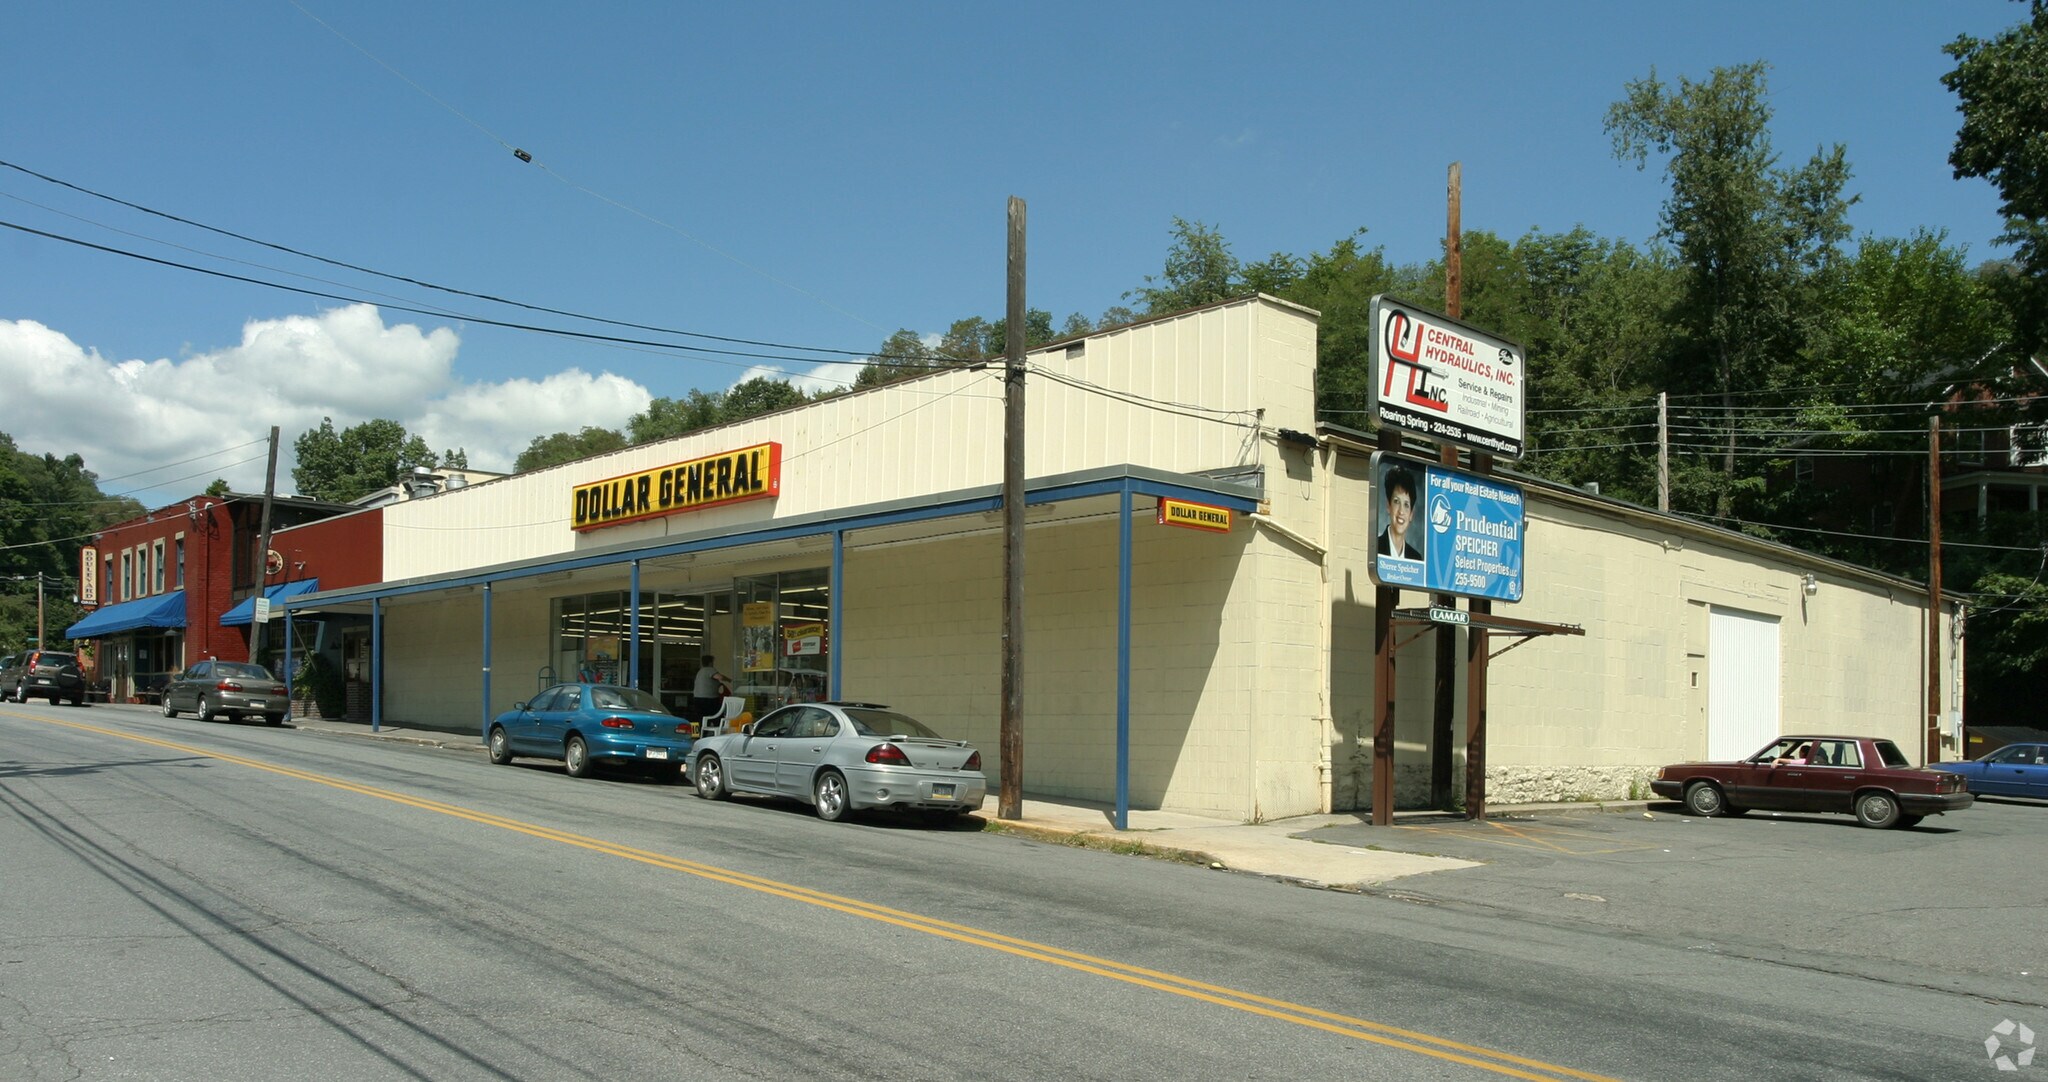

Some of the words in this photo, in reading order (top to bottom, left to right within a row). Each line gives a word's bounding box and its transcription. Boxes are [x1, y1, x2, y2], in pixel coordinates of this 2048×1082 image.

[1428, 329, 1474, 356] CENTRAL
[1425, 345, 1494, 381] HYDRAULICS,
[1495, 369, 1515, 386] INC.
[1458, 378, 1482, 394] Service
[1483, 386, 1488, 396] &
[1489, 388, 1513, 404] Repairs
[1457, 404, 1480, 419] Railroad
[1484, 413, 1514, 429] Agricultural
[1462, 393, 1487, 408] Industrial
[1491, 402, 1509, 417] Mining
[1380, 407, 1406, 426] Roaring
[1407, 414, 1429, 432] Spring
[1434, 422, 1461, 439] 224-2535
[576, 475, 651, 523] DOLLAR
[659, 450, 762, 507] GENERAL
[1431, 474, 1441, 487] For
[1442, 477, 1450, 490] all
[1451, 480, 1465, 493] your
[1465, 482, 1479, 497] Real
[1480, 486, 1499, 502] Estate
[1499, 491, 1519, 506] Needs!
[1171, 507, 1197, 519] DOLLAR
[1199, 511, 1227, 524] GENERAL
[1456, 509, 1518, 541] Prudential
[1455, 534, 1498, 558] SPEICHER
[86, 551, 94, 598] BOULEVARD
[1455, 555, 1476, 571] Select
[1477, 558, 1510, 576] Properties
[1455, 572, 1486, 589] 255-9500
[1433, 610, 1466, 622] LAMAR
